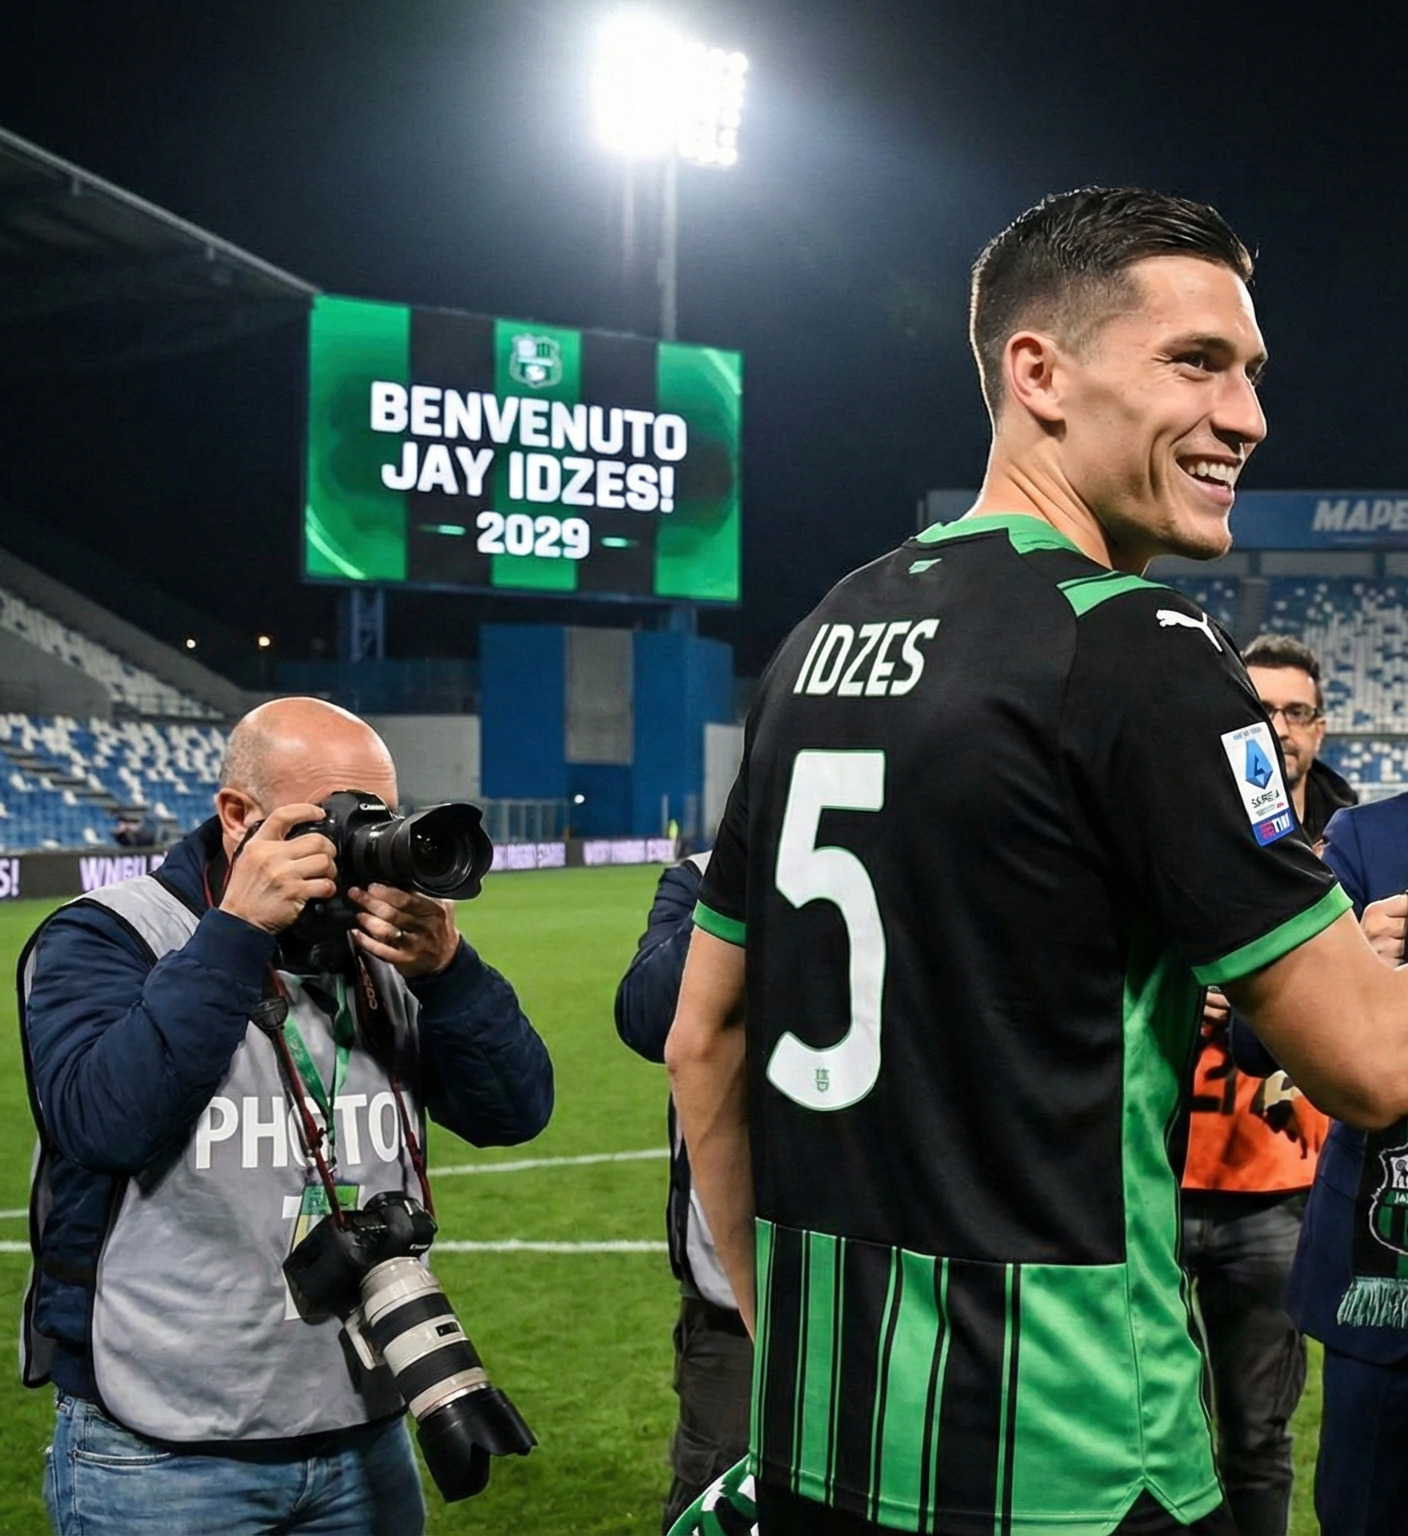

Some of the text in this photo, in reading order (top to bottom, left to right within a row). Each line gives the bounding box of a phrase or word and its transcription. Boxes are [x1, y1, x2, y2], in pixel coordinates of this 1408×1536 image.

[370, 380, 688, 462] BENVENUTO
[381, 442, 675, 514] JAY IDZES!
[475, 510, 591, 560] 2029
[792, 618, 942, 697] IDZES
[766, 749, 886, 1112] 5
